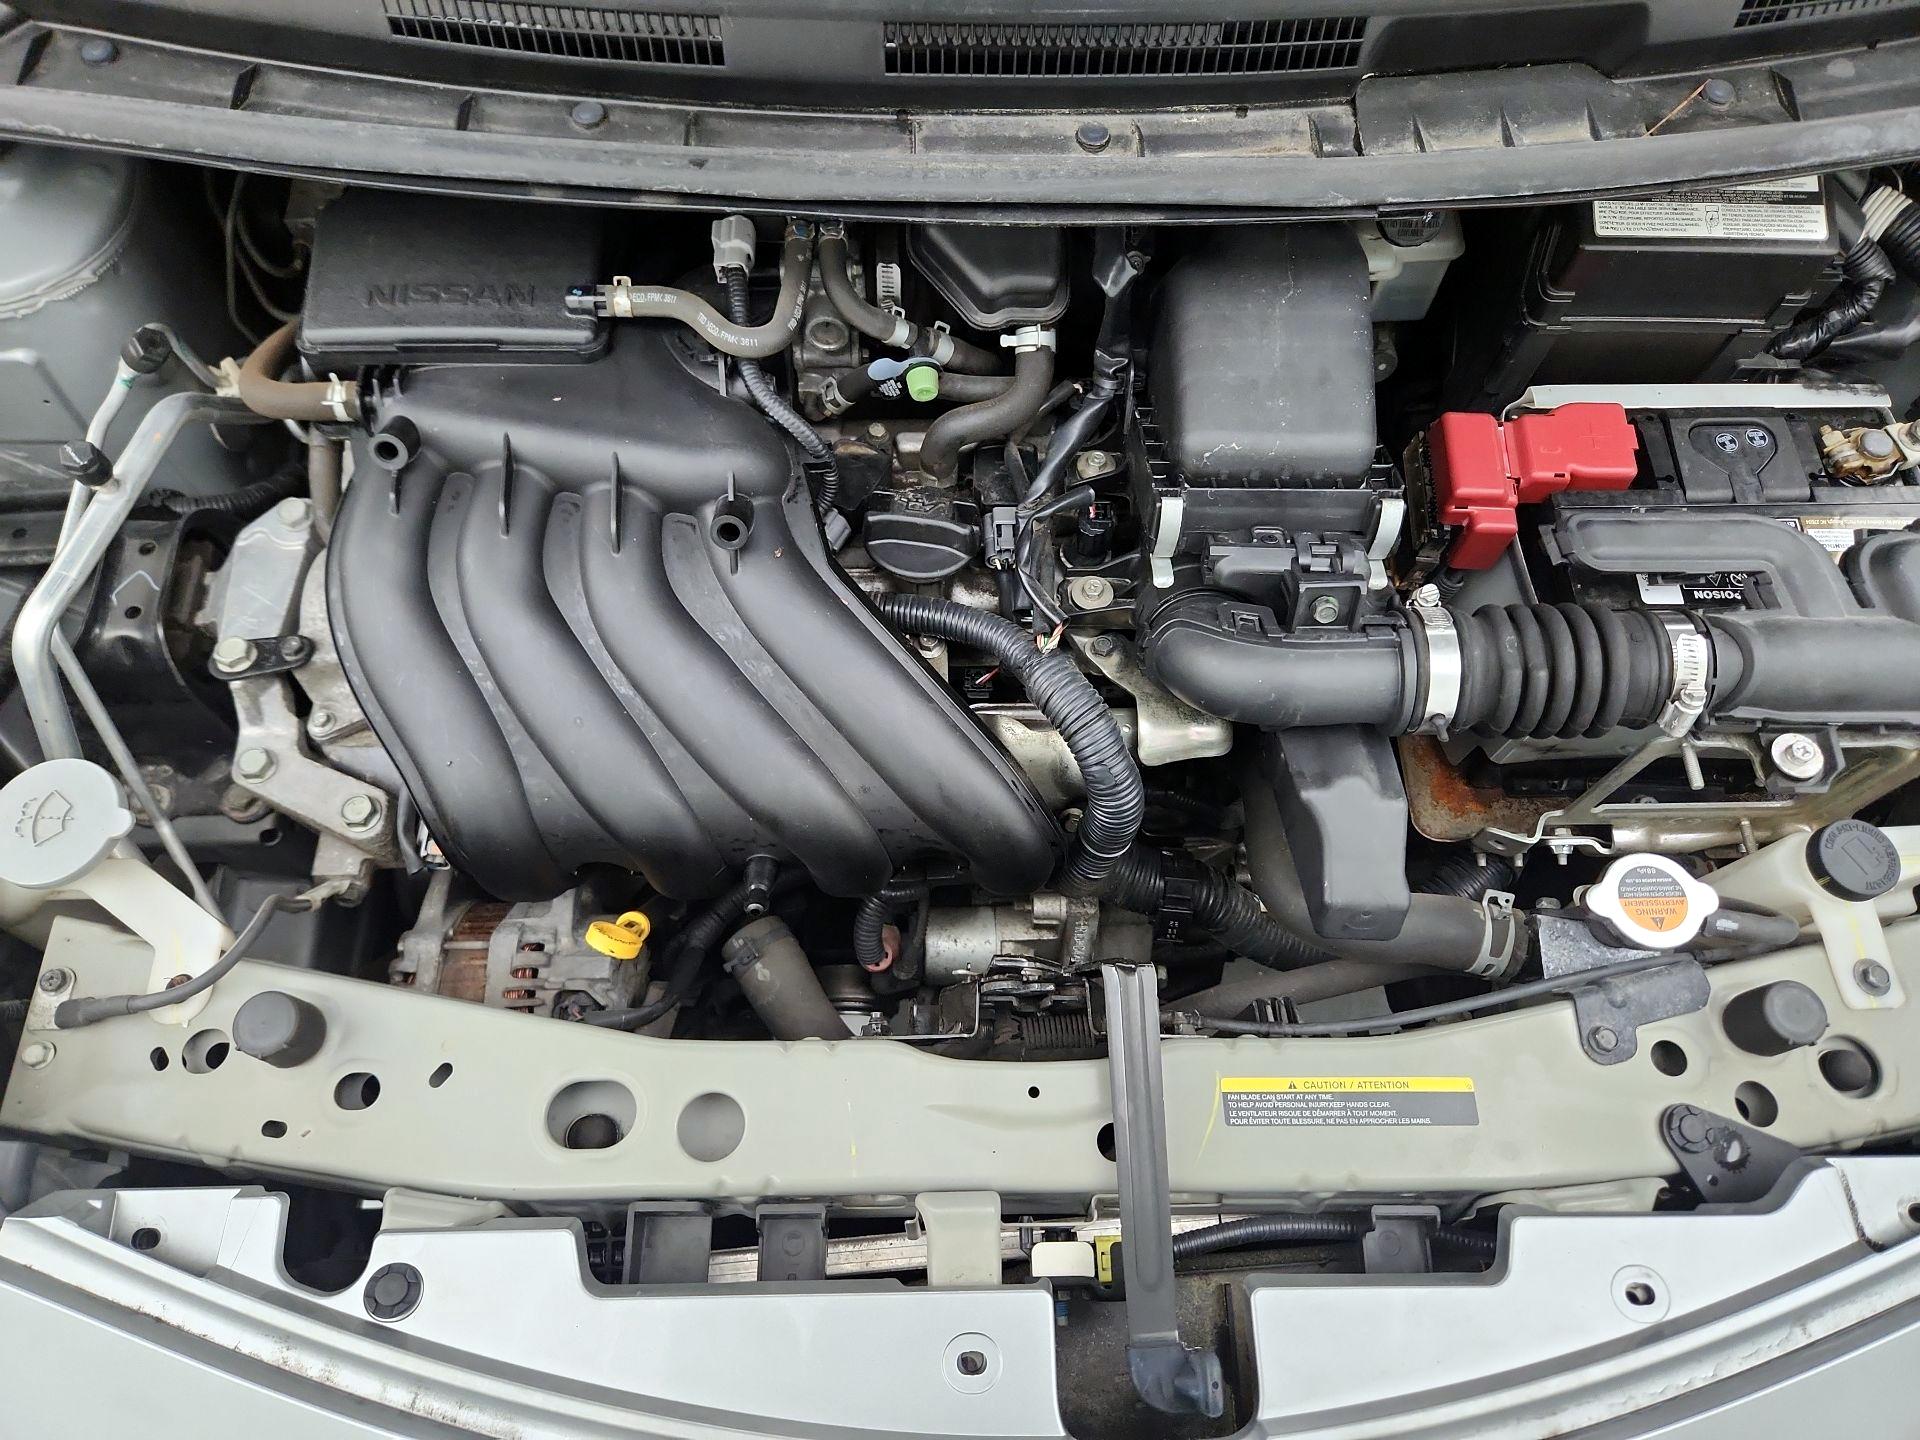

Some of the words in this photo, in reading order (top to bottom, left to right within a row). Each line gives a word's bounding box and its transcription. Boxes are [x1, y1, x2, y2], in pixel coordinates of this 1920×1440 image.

[363, 283, 537, 309] NISSAN
[1693, 590, 1741, 600] POISON
[1624, 899, 1684, 907] AVERTISSEMENT
[1635, 908, 1677, 916] WARNING
[1303, 1081, 1346, 1090] CAUTION
[1357, 1081, 1409, 1090] ATTENTION
[1312, 1108, 1346, 1117] DÉMARRER
[1249, 1116, 1270, 1125] ÉVITER
